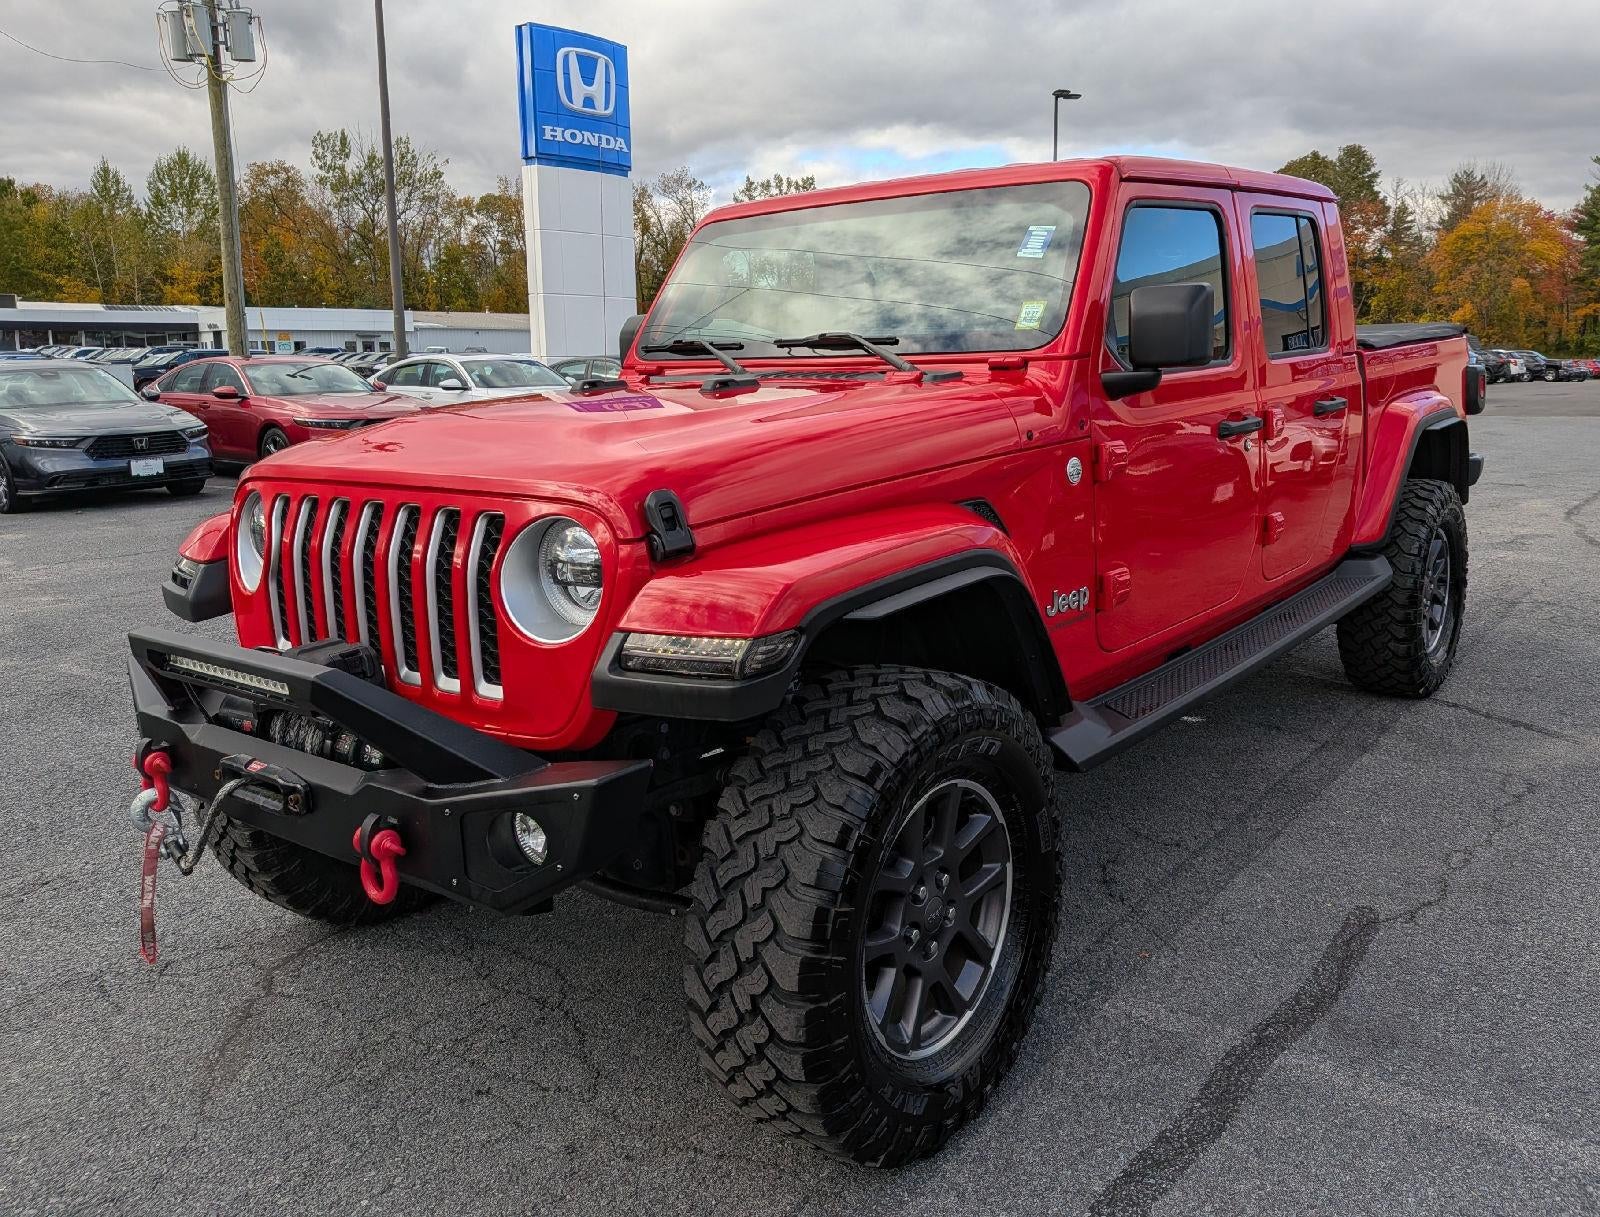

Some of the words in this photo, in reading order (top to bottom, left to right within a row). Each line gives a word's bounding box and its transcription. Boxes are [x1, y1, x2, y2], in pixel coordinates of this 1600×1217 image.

[542, 126, 629, 152] HONDA
[1046, 586, 1090, 617] Jeep
[142, 875, 155, 908] WARN
